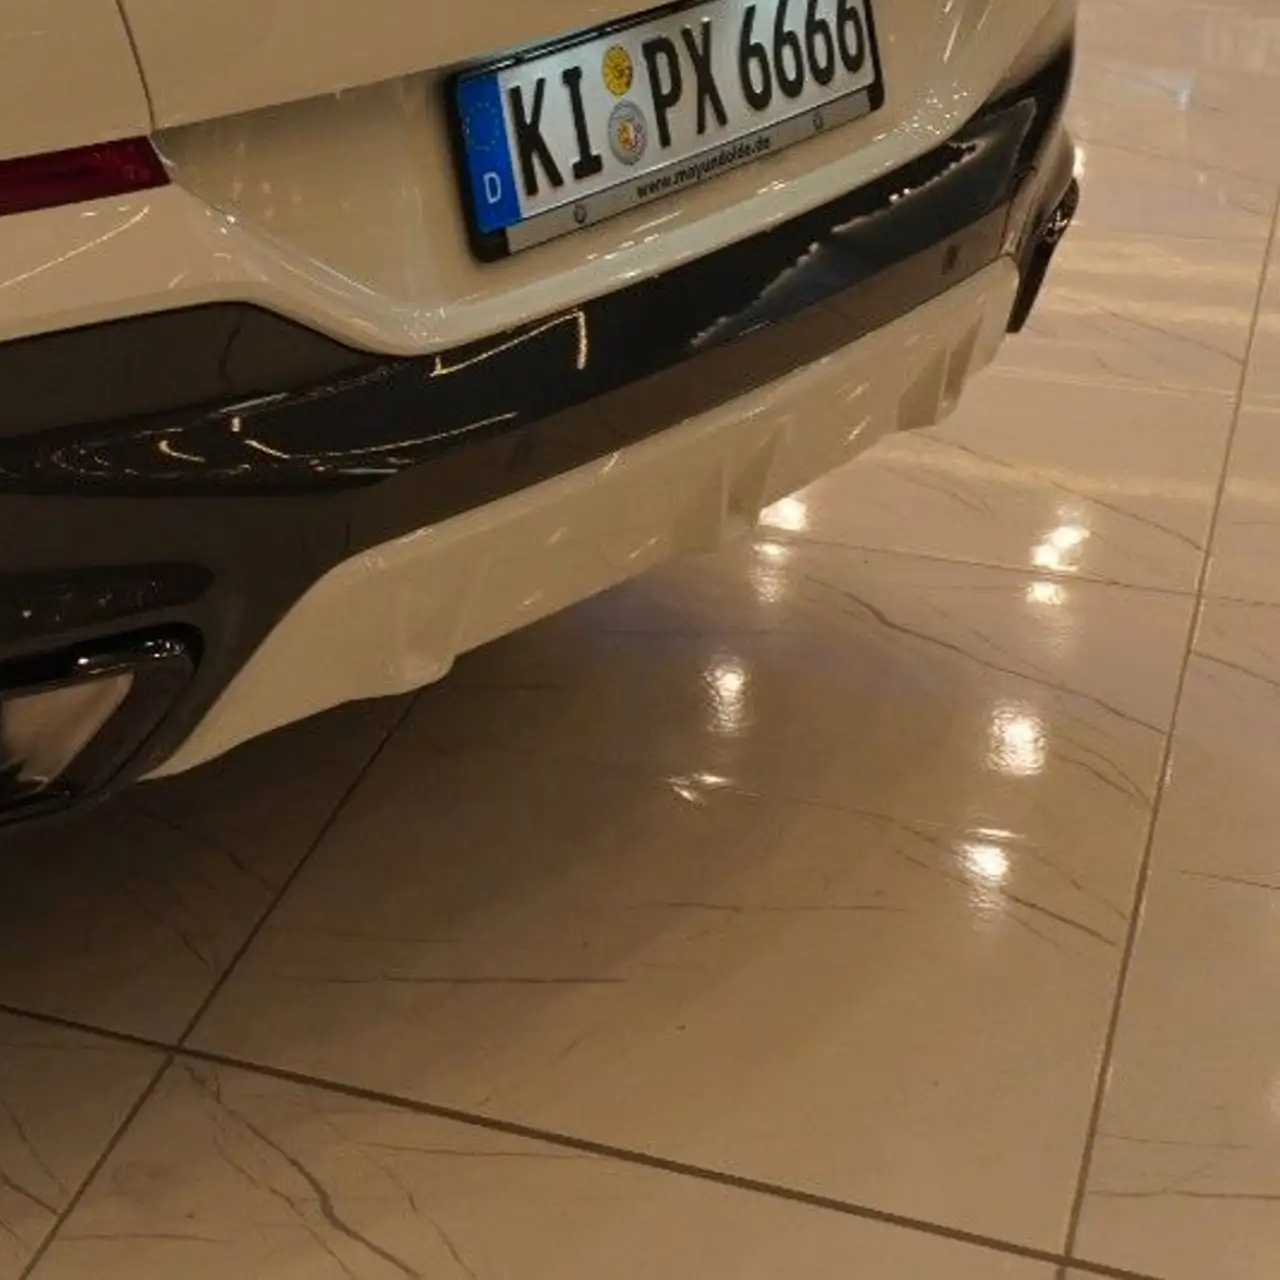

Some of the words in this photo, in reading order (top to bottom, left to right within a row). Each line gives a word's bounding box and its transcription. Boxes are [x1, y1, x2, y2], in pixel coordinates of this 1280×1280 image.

[509, 66, 604, 197] KI
[642, 20, 729, 148] PX
[483, 171, 501, 203] D
